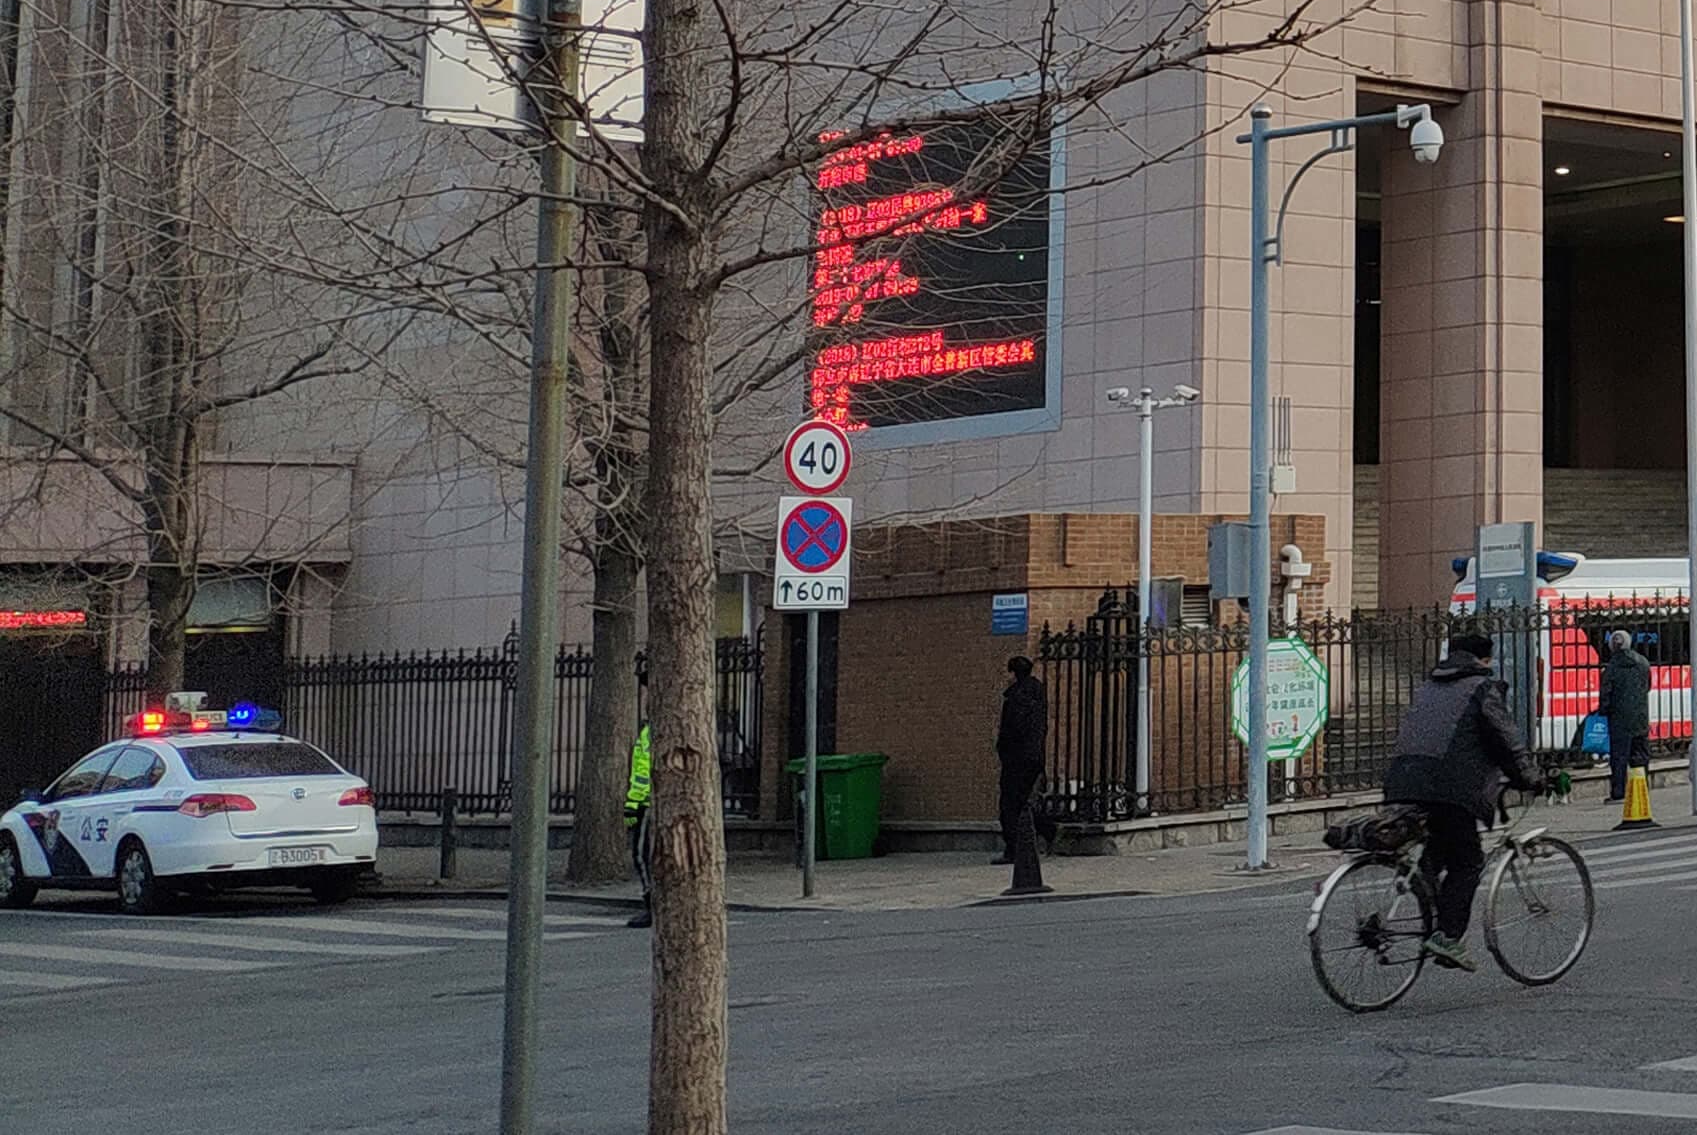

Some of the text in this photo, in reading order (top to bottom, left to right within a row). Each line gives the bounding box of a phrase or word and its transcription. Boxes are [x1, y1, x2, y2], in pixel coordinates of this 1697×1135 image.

[800, 441, 837, 475] 40
[797, 581, 844, 601] 60m
[80, 815, 109, 842] 公安
